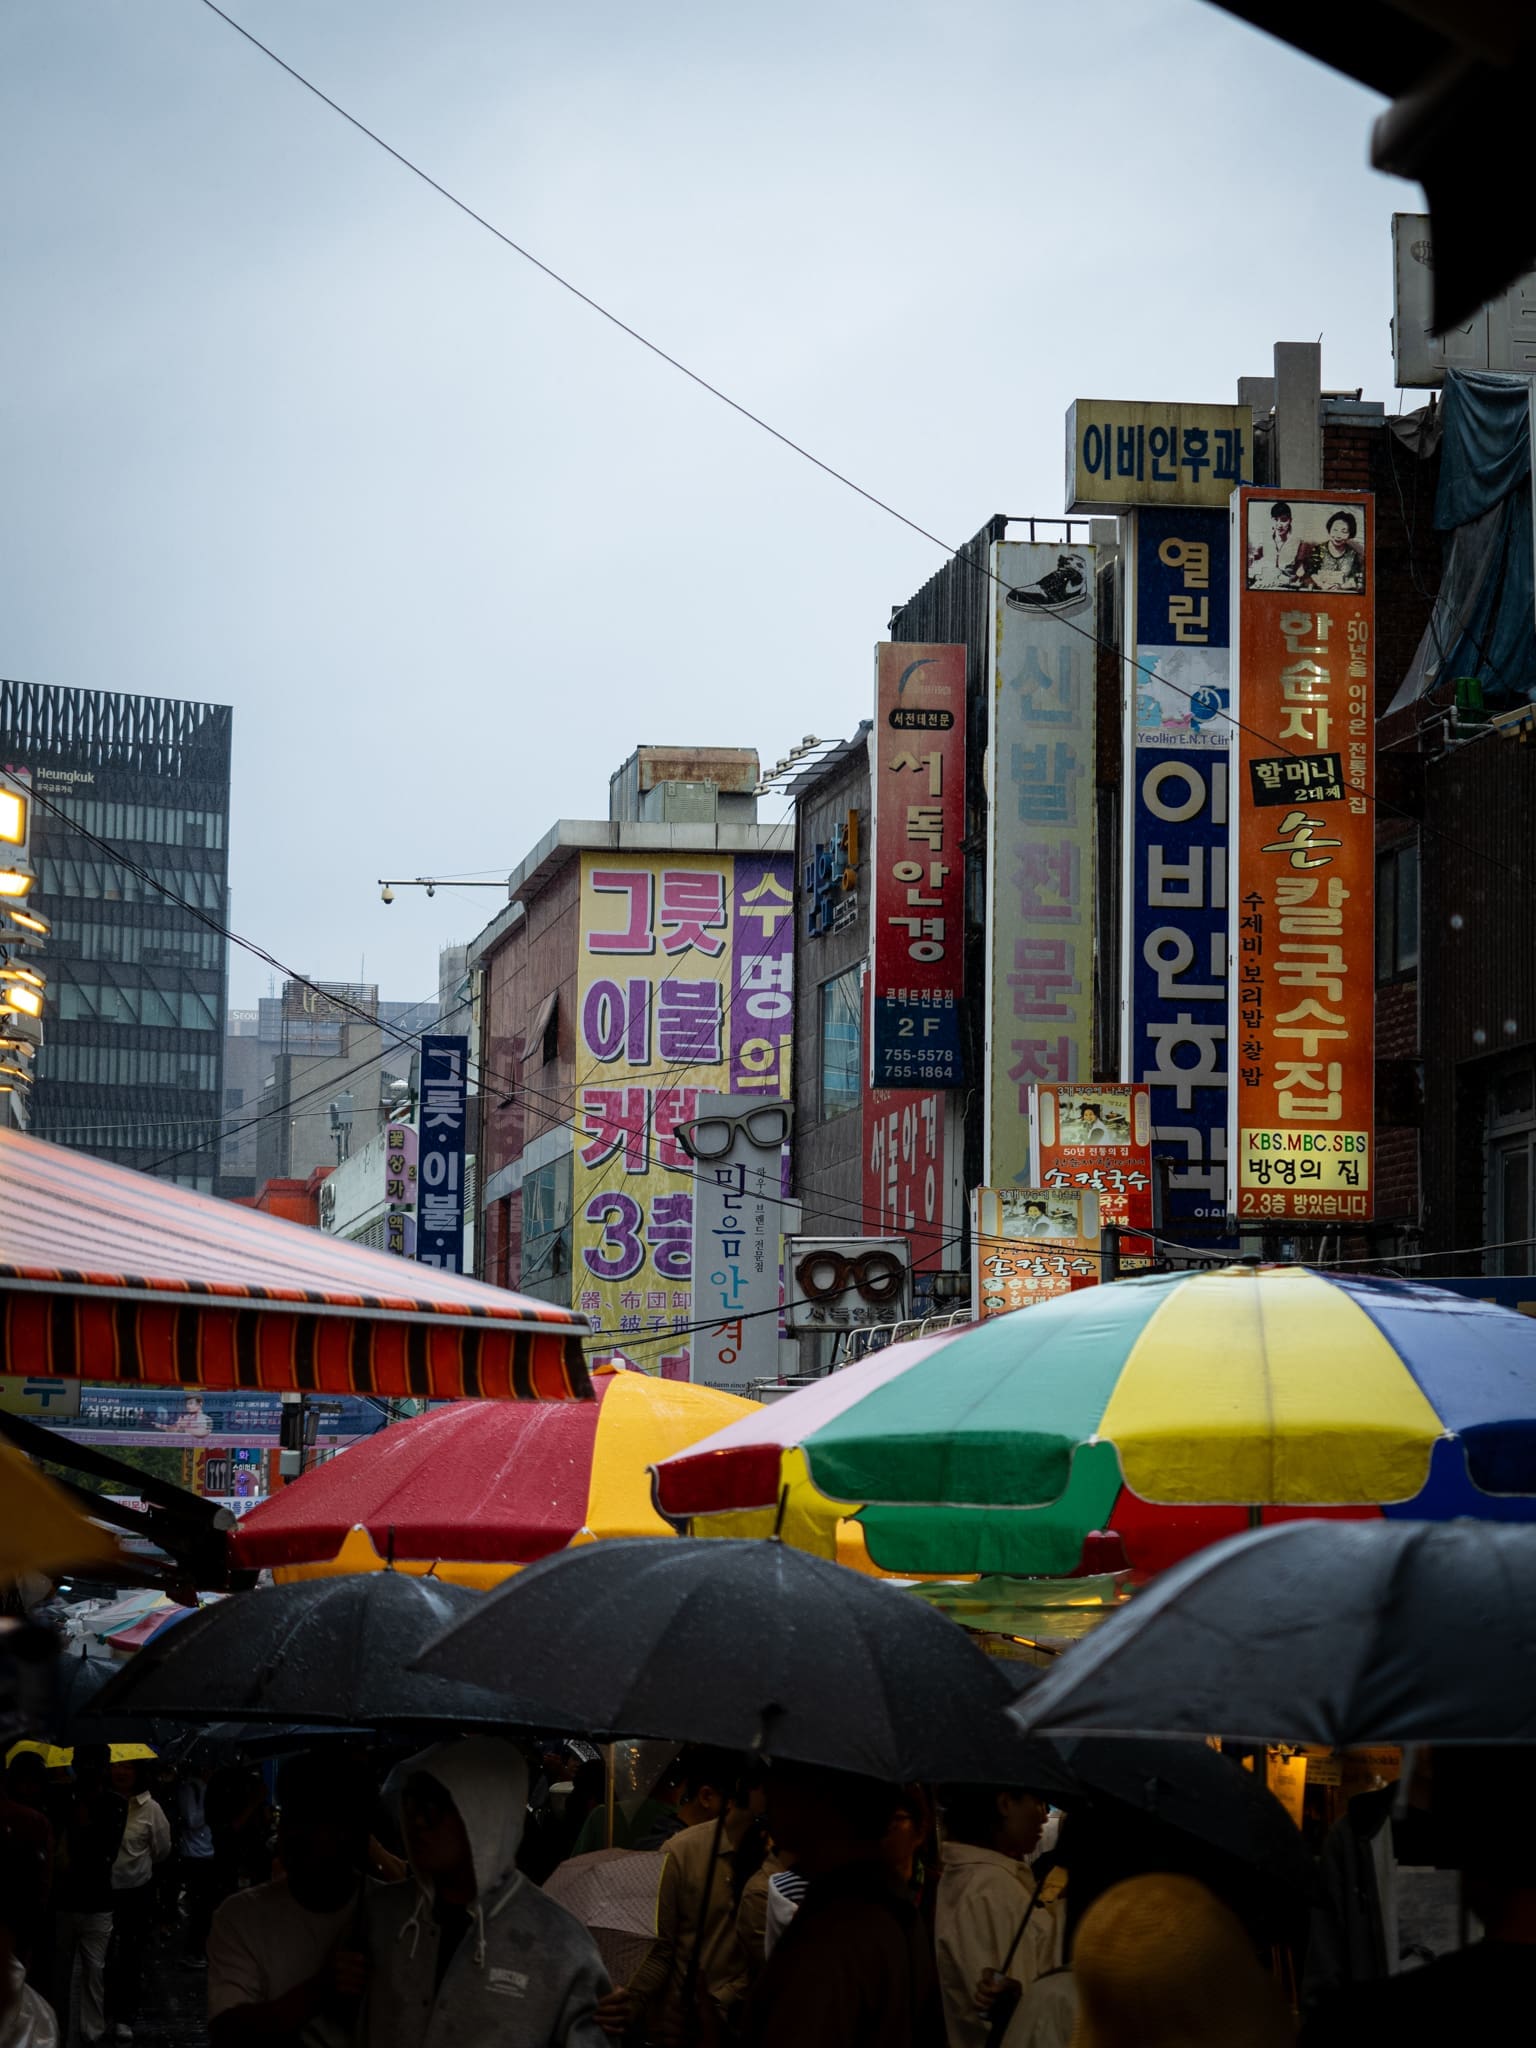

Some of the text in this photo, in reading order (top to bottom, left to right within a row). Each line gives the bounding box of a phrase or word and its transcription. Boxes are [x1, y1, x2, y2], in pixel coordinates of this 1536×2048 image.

[1083, 423, 1245, 485] 이비인후과
[1158, 537, 1210, 643] 열린
[1279, 609, 1334, 749] 한순자
[1347, 685, 1368, 736] 이어온
[1138, 732, 1177, 744] Yeollin
[1179, 733, 1208, 745] E.N.T
[36, 767, 95, 784] Heungkuk
[1255, 757, 1336, 790] 할머니
[1347, 743, 1368, 790] 전통의
[1347, 797, 1368, 815] 집
[888, 750, 951, 964] 서독안경
[586, 868, 728, 957] 그릇
[885, 987, 954, 1009] 콘택트전문점
[1142, 760, 1230, 1203] 이비인후과
[582, 978, 726, 1066] 이불
[884, 1048, 954, 1062] 755-5578
[884, 1065, 954, 1080] 755-1864
[1063, 1146, 1086, 1157] 50년
[1119, 1146, 1129, 1157] 집
[1248, 1158, 1360, 1186] 방영의 집
[1293, 1193, 1368, 1217] 방있습니다
[388, 1215, 405, 1257] 액세
